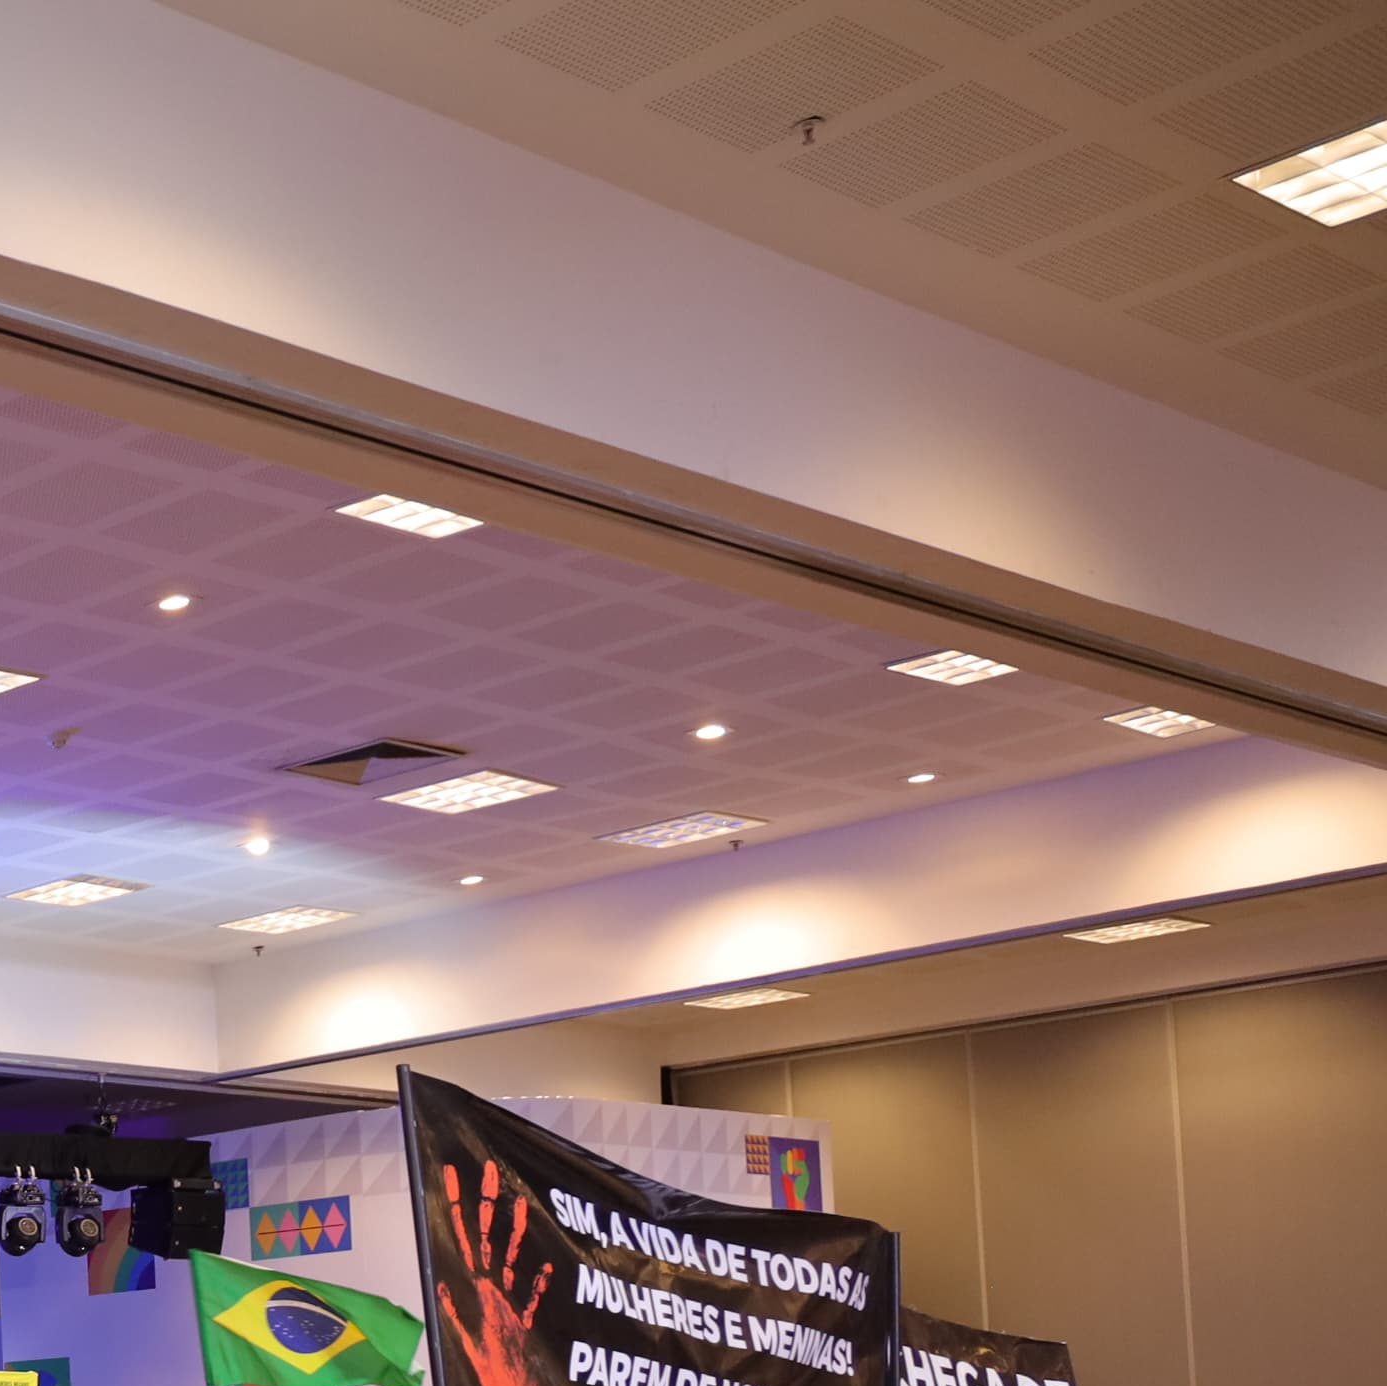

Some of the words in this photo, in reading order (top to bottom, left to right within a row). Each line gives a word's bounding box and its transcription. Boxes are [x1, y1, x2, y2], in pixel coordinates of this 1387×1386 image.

[549, 1187, 608, 1248] SIM,
[610, 1211, 635, 1251] A
[629, 1216, 708, 1272] VIDA
[706, 1238, 749, 1283] DE
[750, 1248, 855, 1304] TODAS
[849, 1272, 870, 1311] AS
[576, 1264, 722, 1345] MULHERES
[723, 1310, 748, 1349] E
[748, 1315, 855, 1377] MENINAS!
